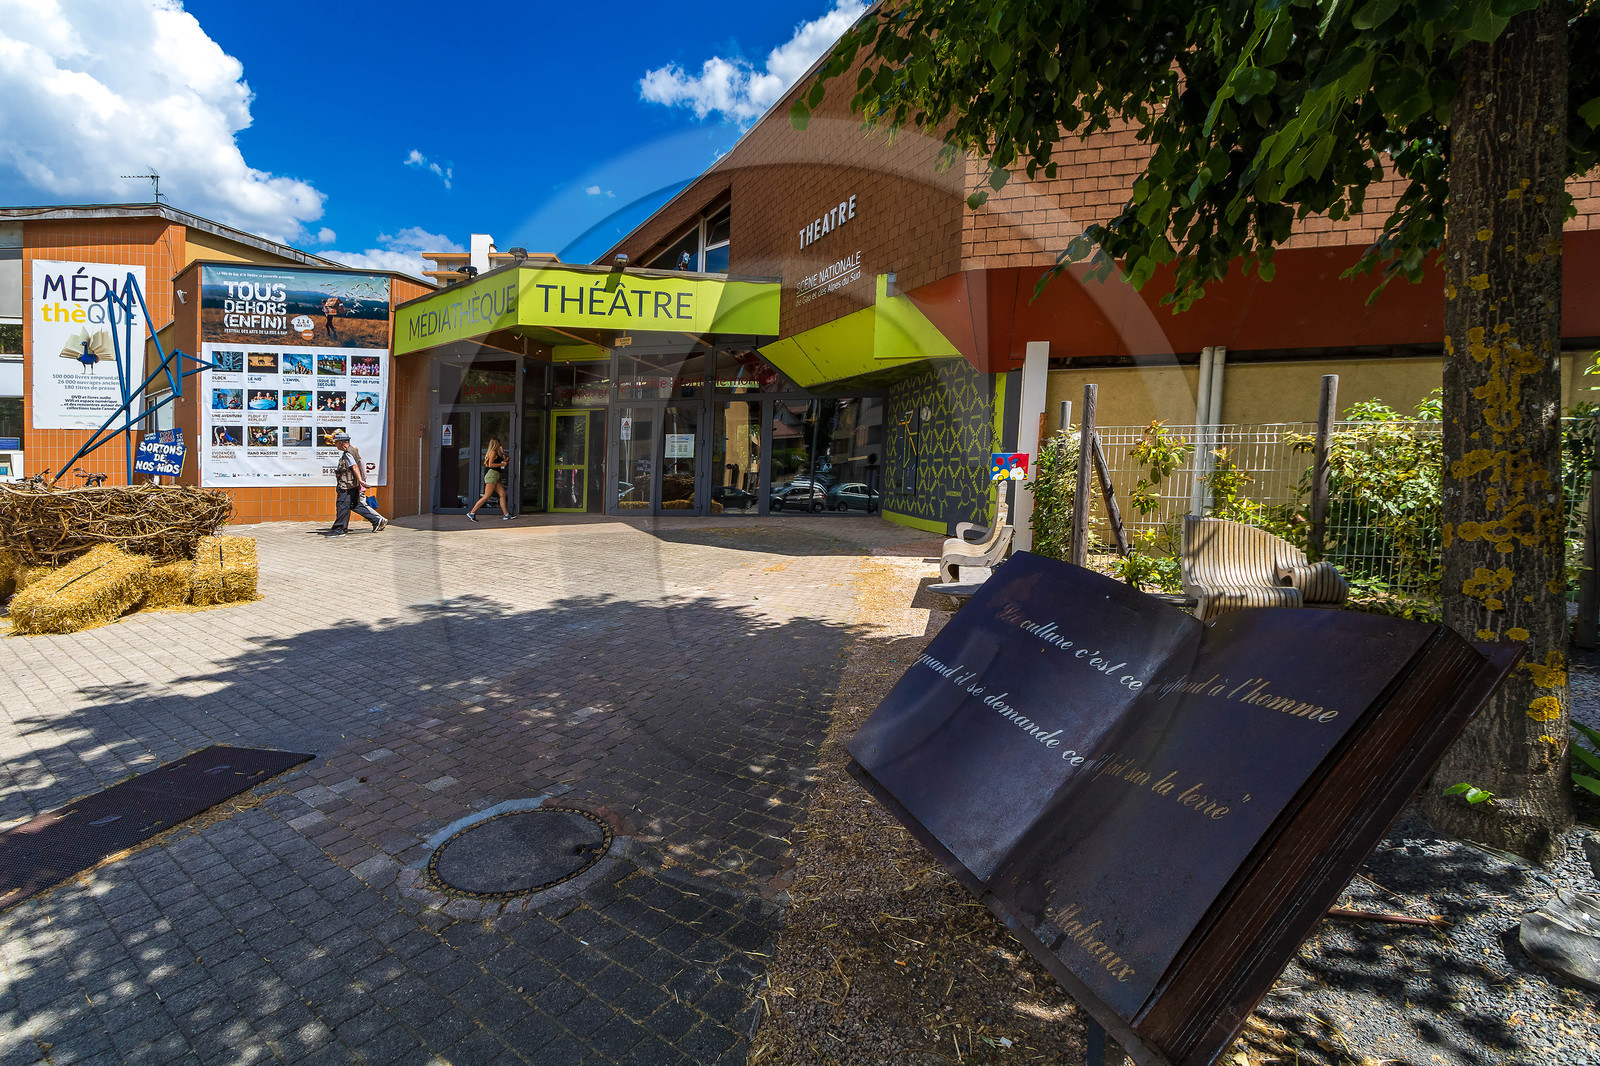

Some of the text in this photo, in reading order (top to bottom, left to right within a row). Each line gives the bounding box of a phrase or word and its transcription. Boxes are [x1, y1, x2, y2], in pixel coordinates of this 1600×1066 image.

[799, 194, 856, 250] THEATRE
[796, 250, 861, 294] SCÈNE NATIONALE
[828, 280, 841, 293] Alpes
[842, 276, 850, 286] du
[850, 269, 861, 282] Sud
[43, 266, 136, 304] MÉDIA
[223, 280, 287, 302] TOUS
[224, 300, 287, 316] DEHORS
[536, 280, 694, 320] THÉÂTRE
[224, 314, 287, 330] (ENFIN)!
[408, 284, 516, 341] MÉDIATHÈQUE
[463, 384, 514, 395] La culture
[139, 441, 183, 456] SORTONS
[154, 454, 167, 462] DE
[136, 460, 180, 474] NOS NIDS
[1020, 621, 1074, 650] culture
[1075, 648, 1127, 676] c'est
[1120, 675, 1143, 691] ce
[1226, 677, 1339, 723] l'homme
[912, 653, 964, 678] quand
[983, 693, 1063, 749] demande
[1062, 750, 1084, 767] ce
[1151, 770, 1178, 797] la
